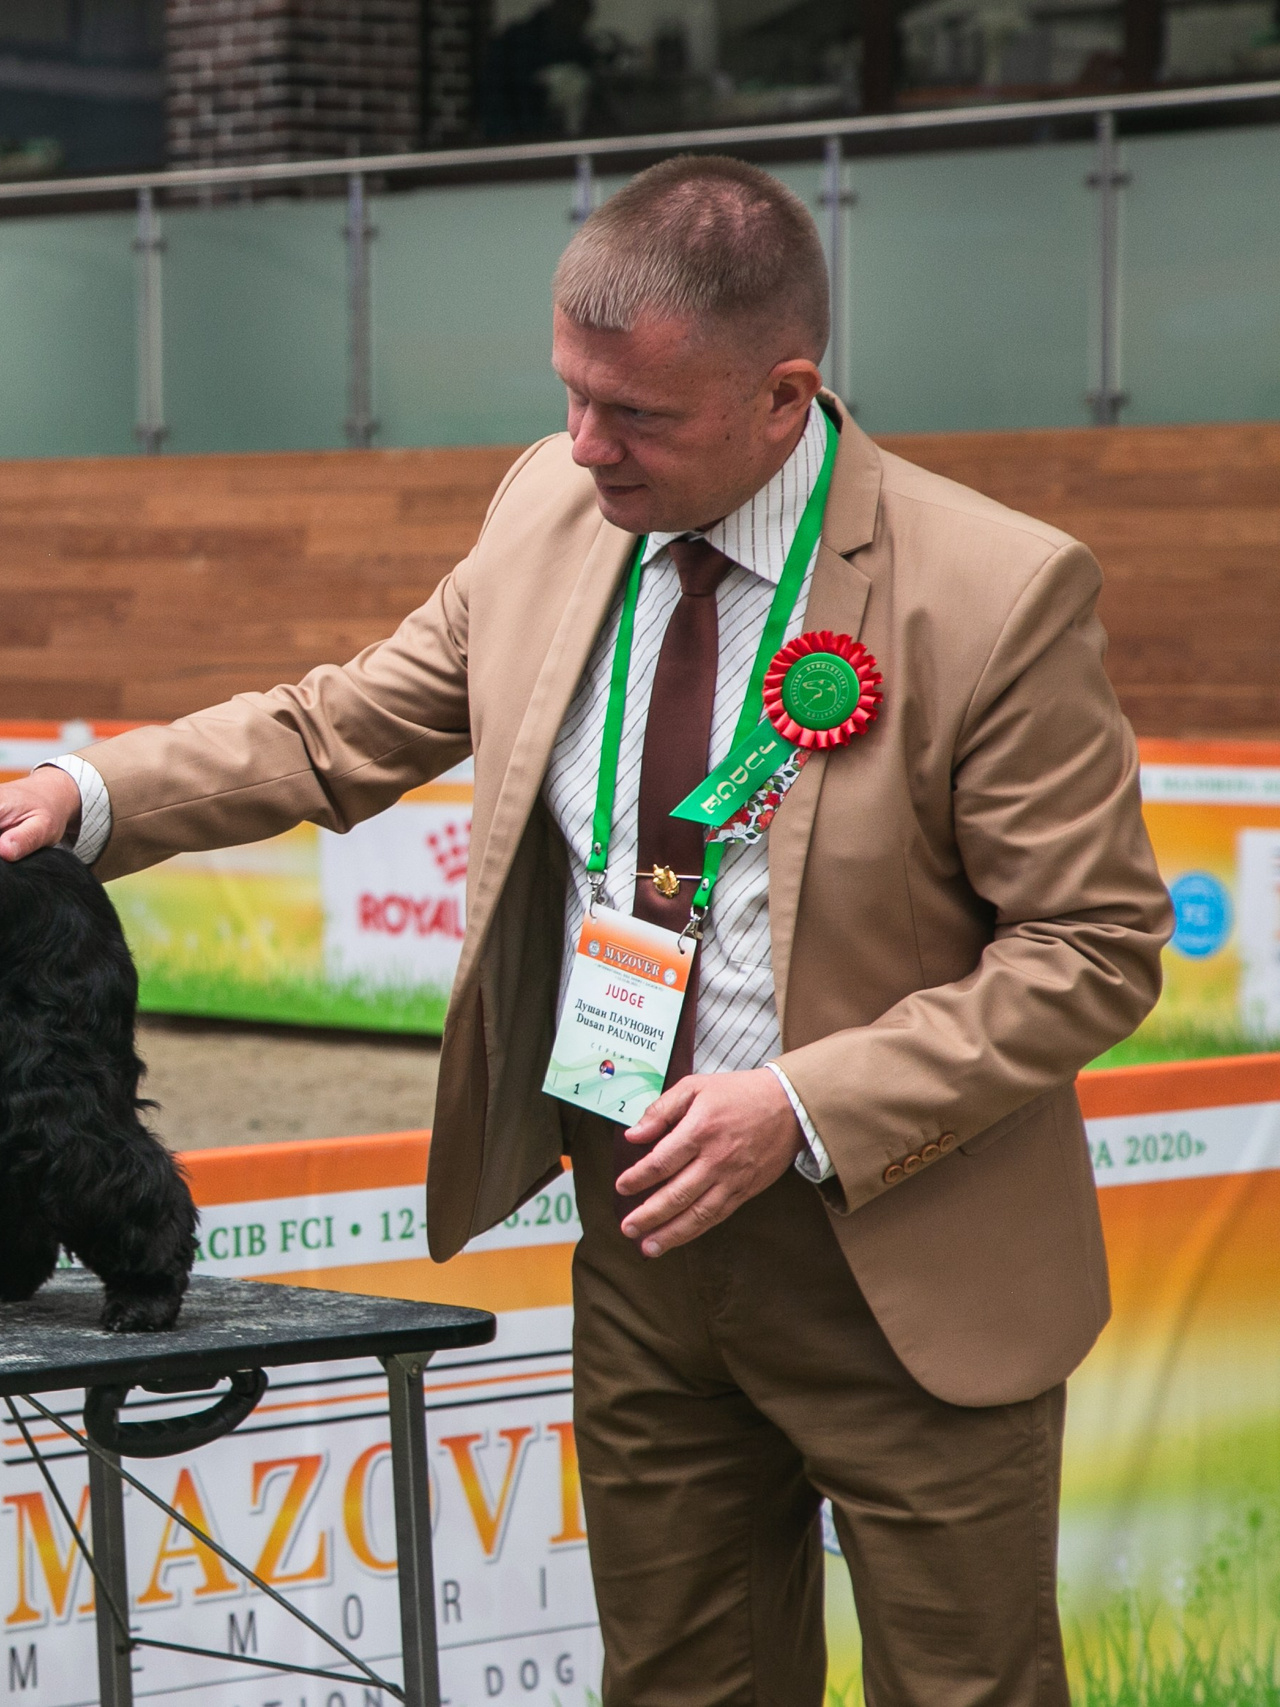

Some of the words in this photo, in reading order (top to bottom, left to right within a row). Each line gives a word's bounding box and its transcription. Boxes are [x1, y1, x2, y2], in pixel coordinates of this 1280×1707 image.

[700, 740, 778, 815] JUDGE
[358, 892, 465, 939] ROYAL
[604, 946, 661, 977] MAZOVER
[606, 983, 646, 1009] JUDGE
[575, 998, 607, 1020] Душан
[609, 1011, 665, 1041] ПАУНОВИЧ
[576, 1013, 605, 1032] Dusan
[607, 1024, 658, 1052] PAUNOVIC
[573, 1083, 580, 1095] 1
[618, 1100, 626, 1113] 2
[279, 1216, 336, 1254] FCI
[485, 1653, 575, 1697] DOG
